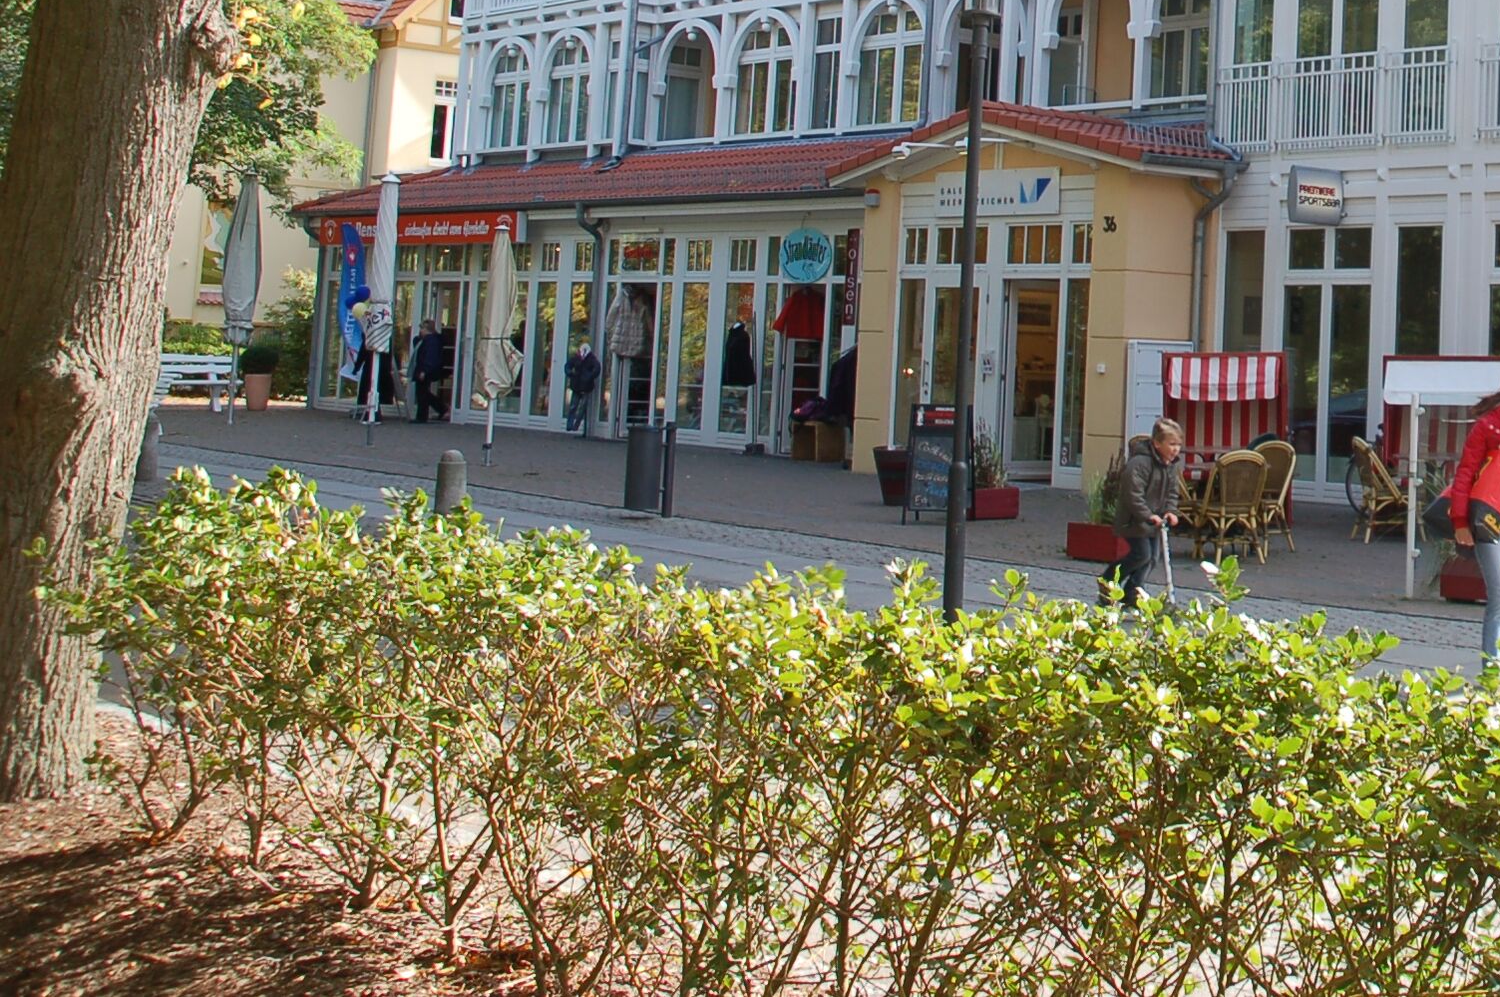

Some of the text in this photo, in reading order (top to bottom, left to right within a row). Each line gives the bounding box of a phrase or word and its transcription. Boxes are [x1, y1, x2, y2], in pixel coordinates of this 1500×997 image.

[1299, 184, 1335, 196] PREMIERE
[1299, 195, 1341, 208] SPORTSBAR
[1103, 215, 1117, 233] 36
[845, 248, 857, 315] olsen
